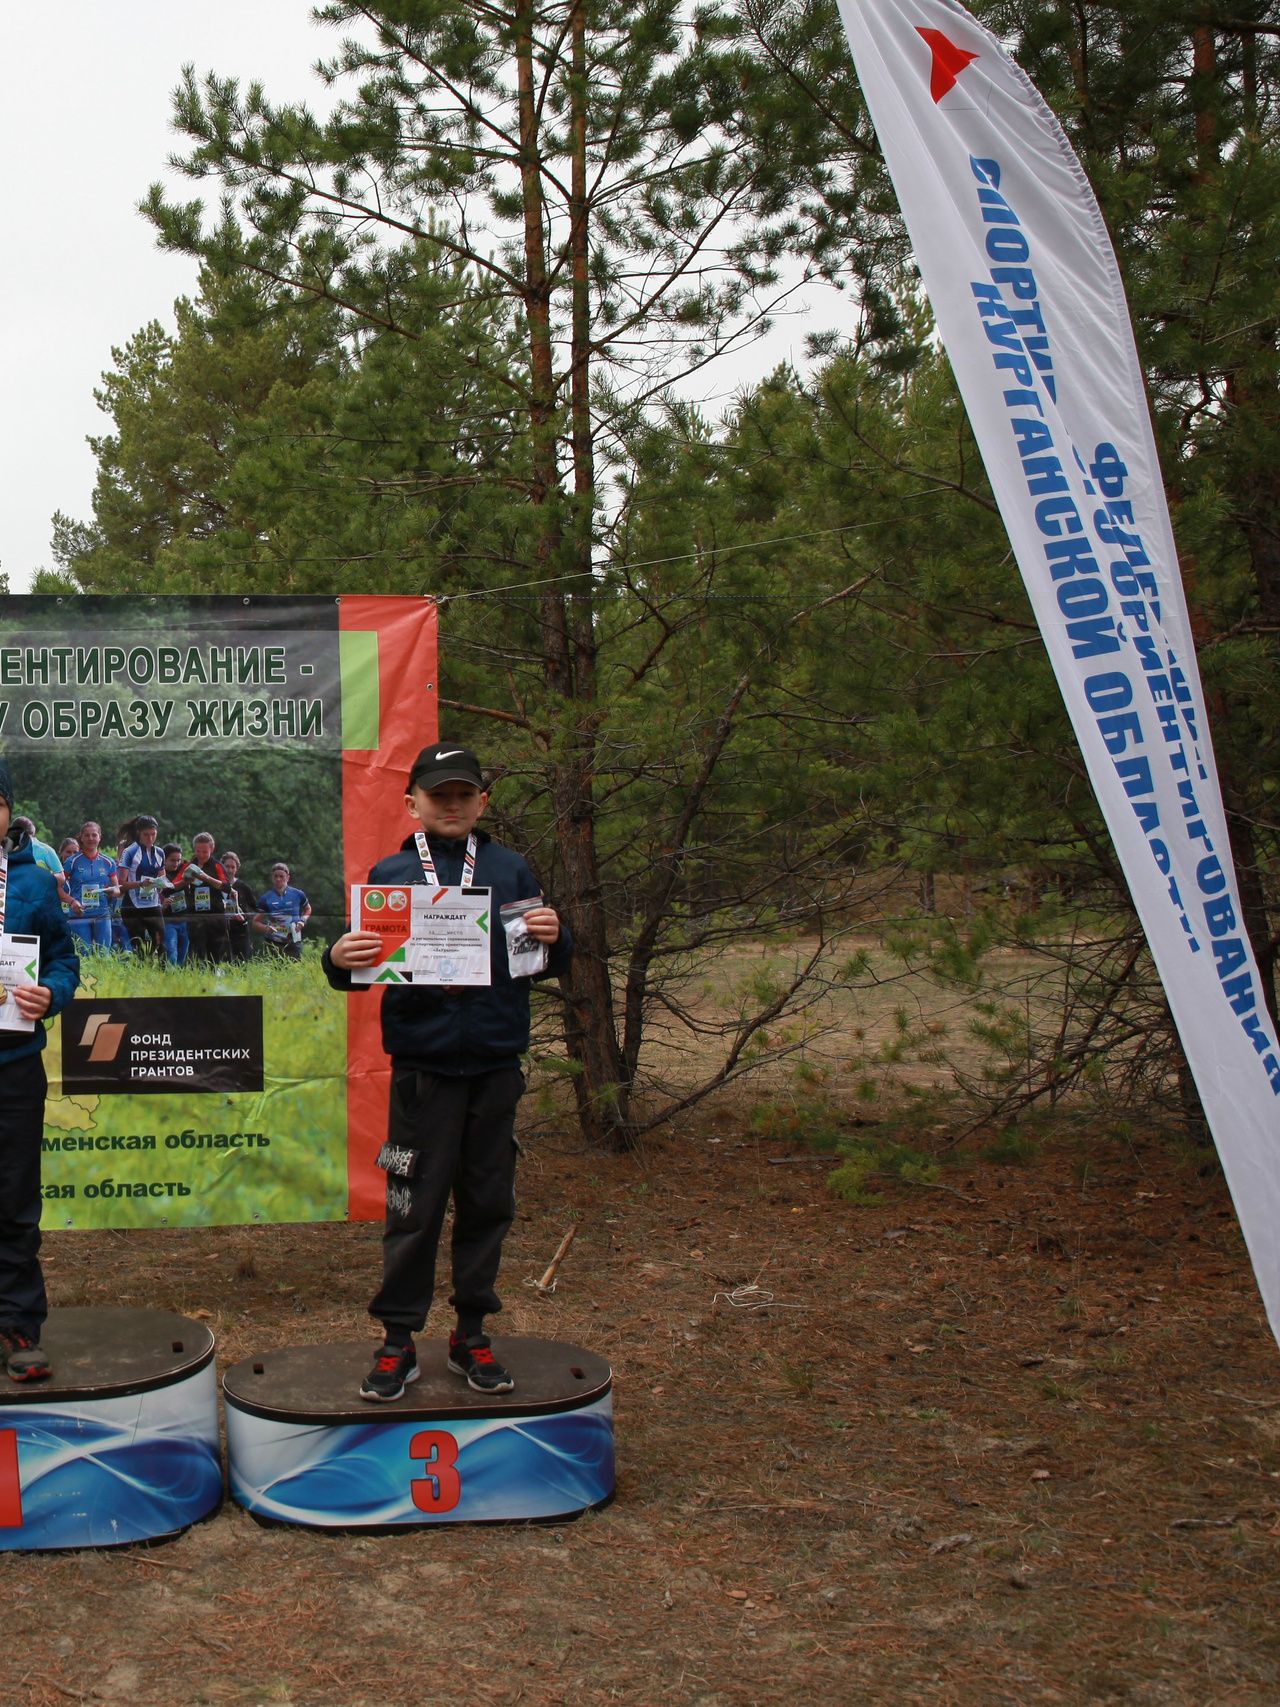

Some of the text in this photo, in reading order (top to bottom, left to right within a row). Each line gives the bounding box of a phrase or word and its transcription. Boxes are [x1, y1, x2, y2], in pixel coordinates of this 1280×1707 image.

[970, 281, 1128, 660] КУРГАНСКОЙ
[22, 700, 174, 739] ОБРАЗУ
[187, 699, 323, 737] ЖИЗНИ
[366, 925, 407, 933] ГРАМОТА
[130, 1033, 172, 1047] ФОНД
[130, 1047, 251, 1062] ПРЕЗИДЕНТСКИХ
[130, 1065, 195, 1078] ГРАНТОВ
[42, 1129, 270, 1151] менская область
[83, 1179, 191, 1198] область
[409, 1430, 461, 1513] 3
